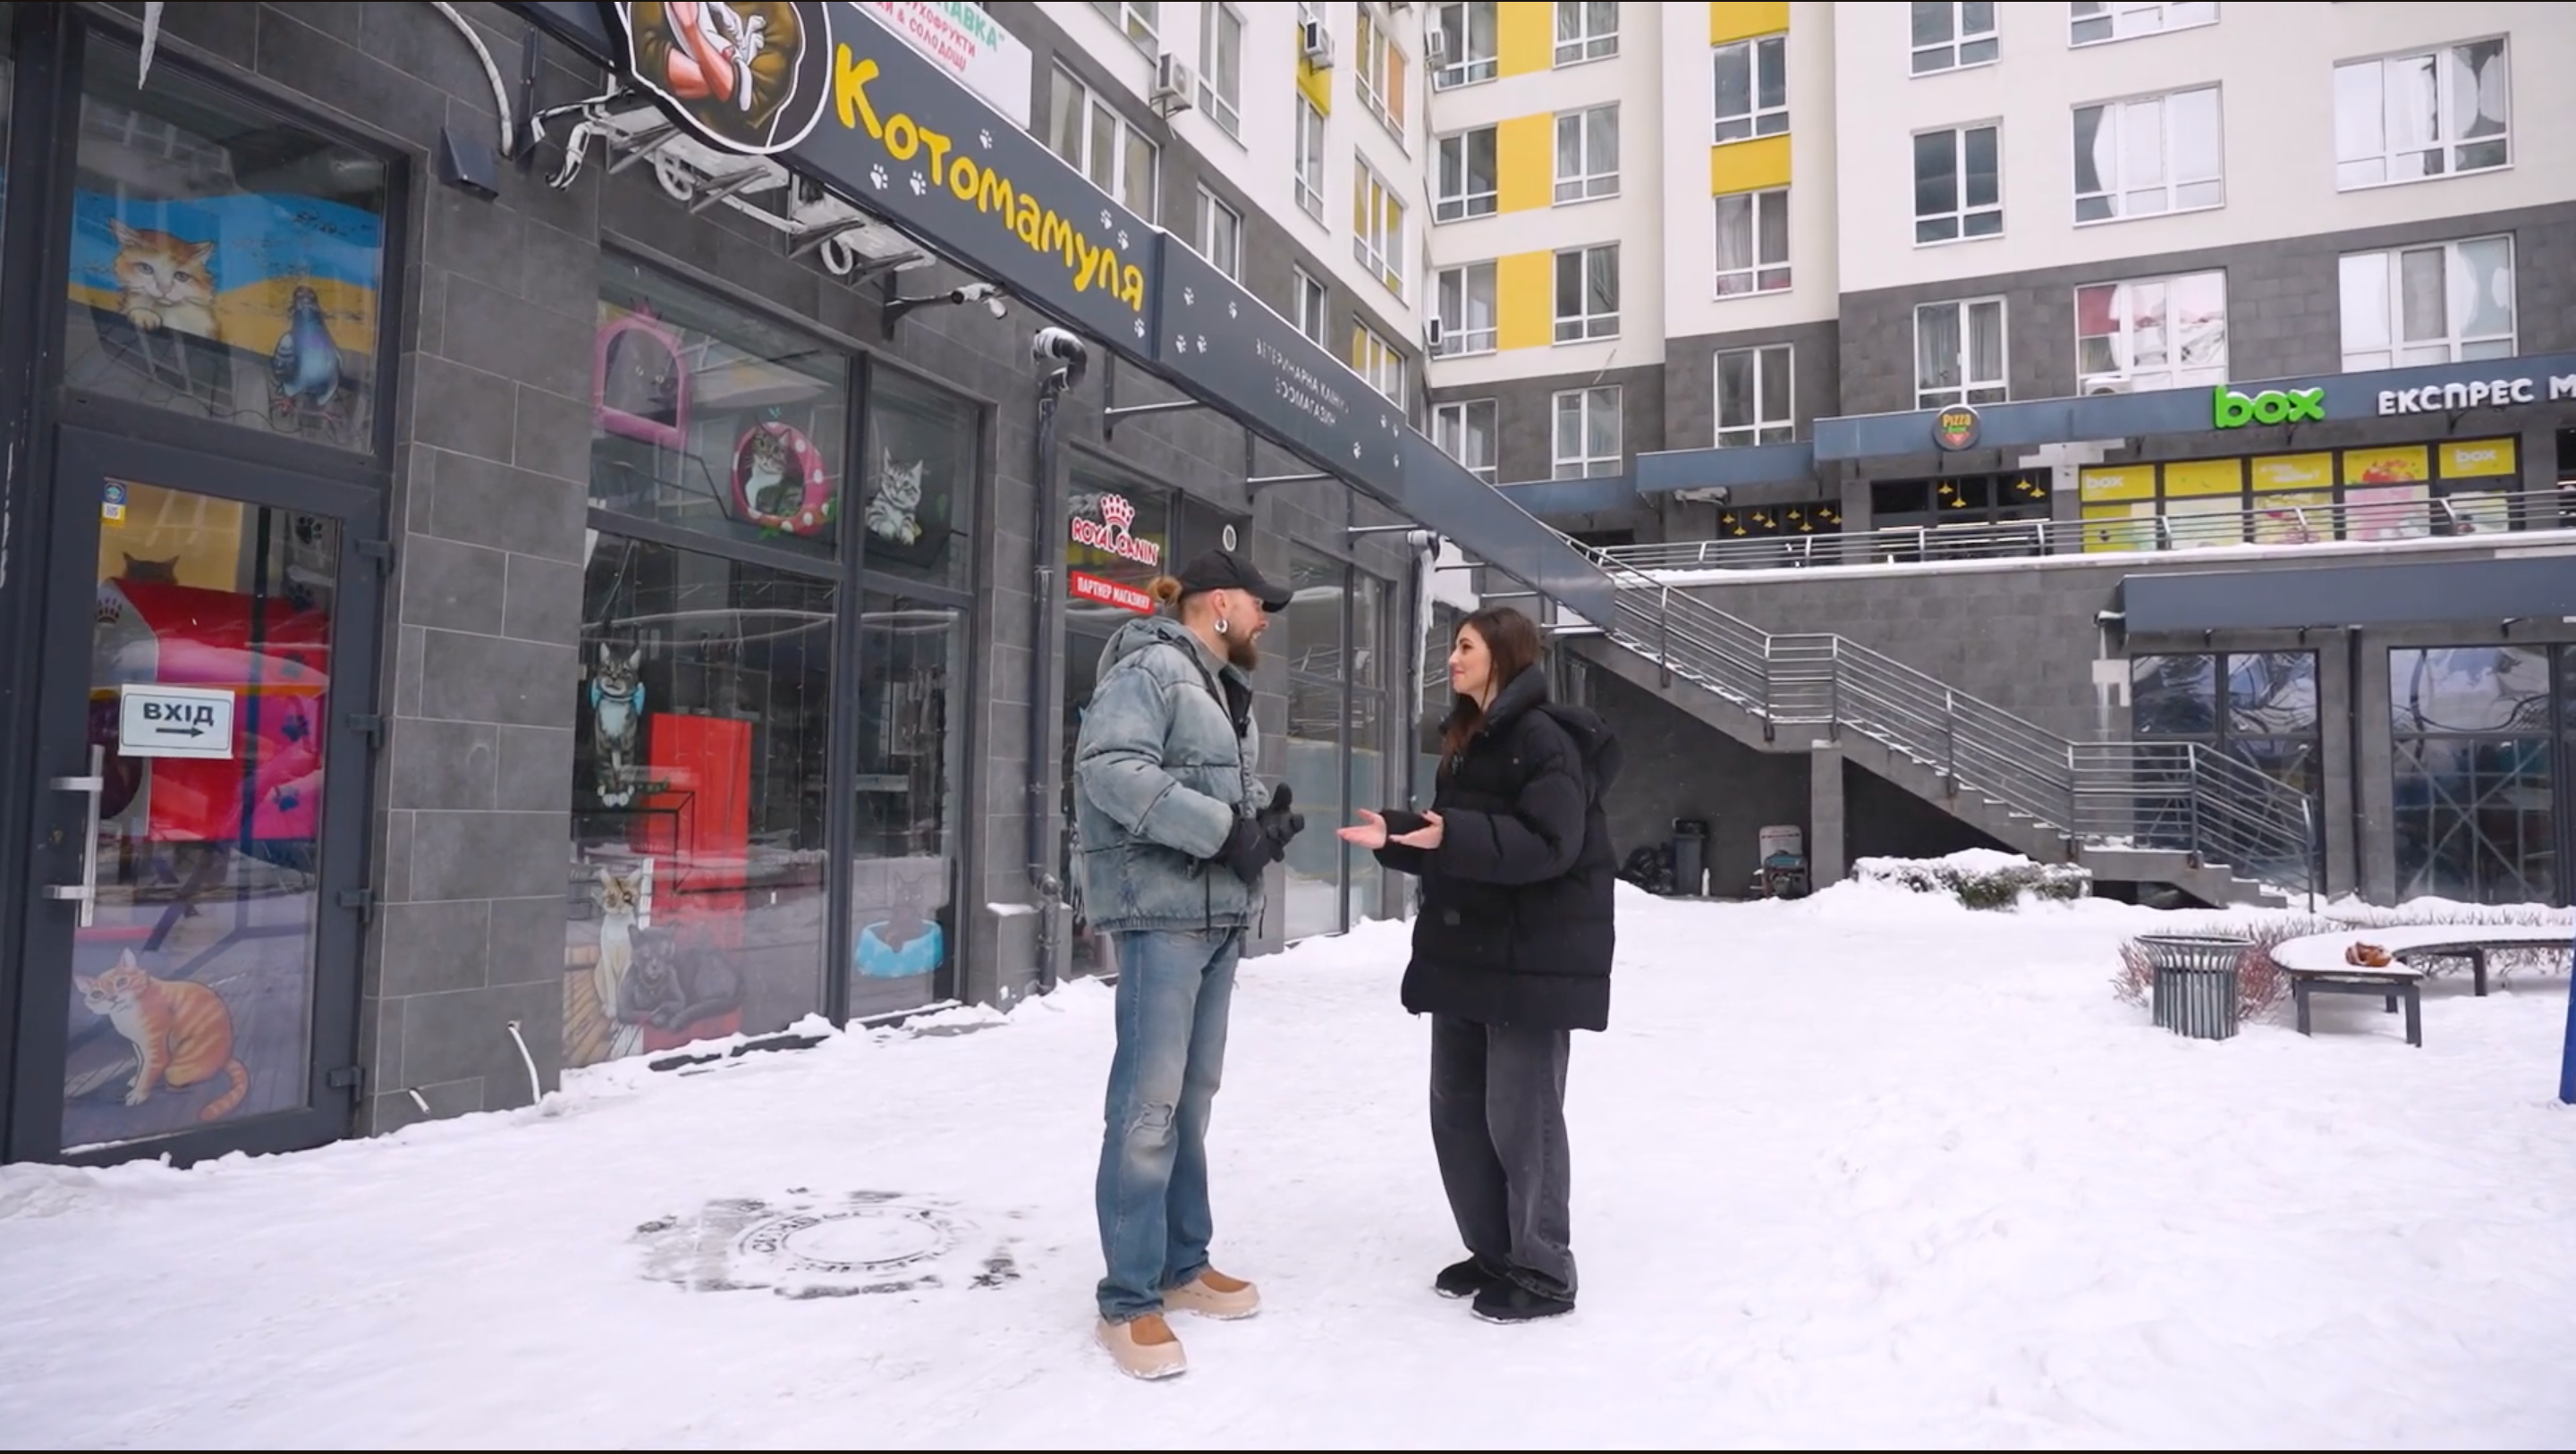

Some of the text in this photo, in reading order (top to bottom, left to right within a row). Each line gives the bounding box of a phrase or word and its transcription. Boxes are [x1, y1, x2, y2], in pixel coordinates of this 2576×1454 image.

[906, 2, 975, 58] УХОФРУКТИ
[2214, 385, 2325, 428] box
[2378, 377, 2535, 416] ЕКСПРЕС
[2455, 448, 2497, 463] box
[2085, 474, 2124, 489] box
[1072, 517, 1160, 567] ROYAL CANIN
[1077, 577, 1112, 600] ПАРТНЕР
[143, 702, 214, 727] ВХІД
